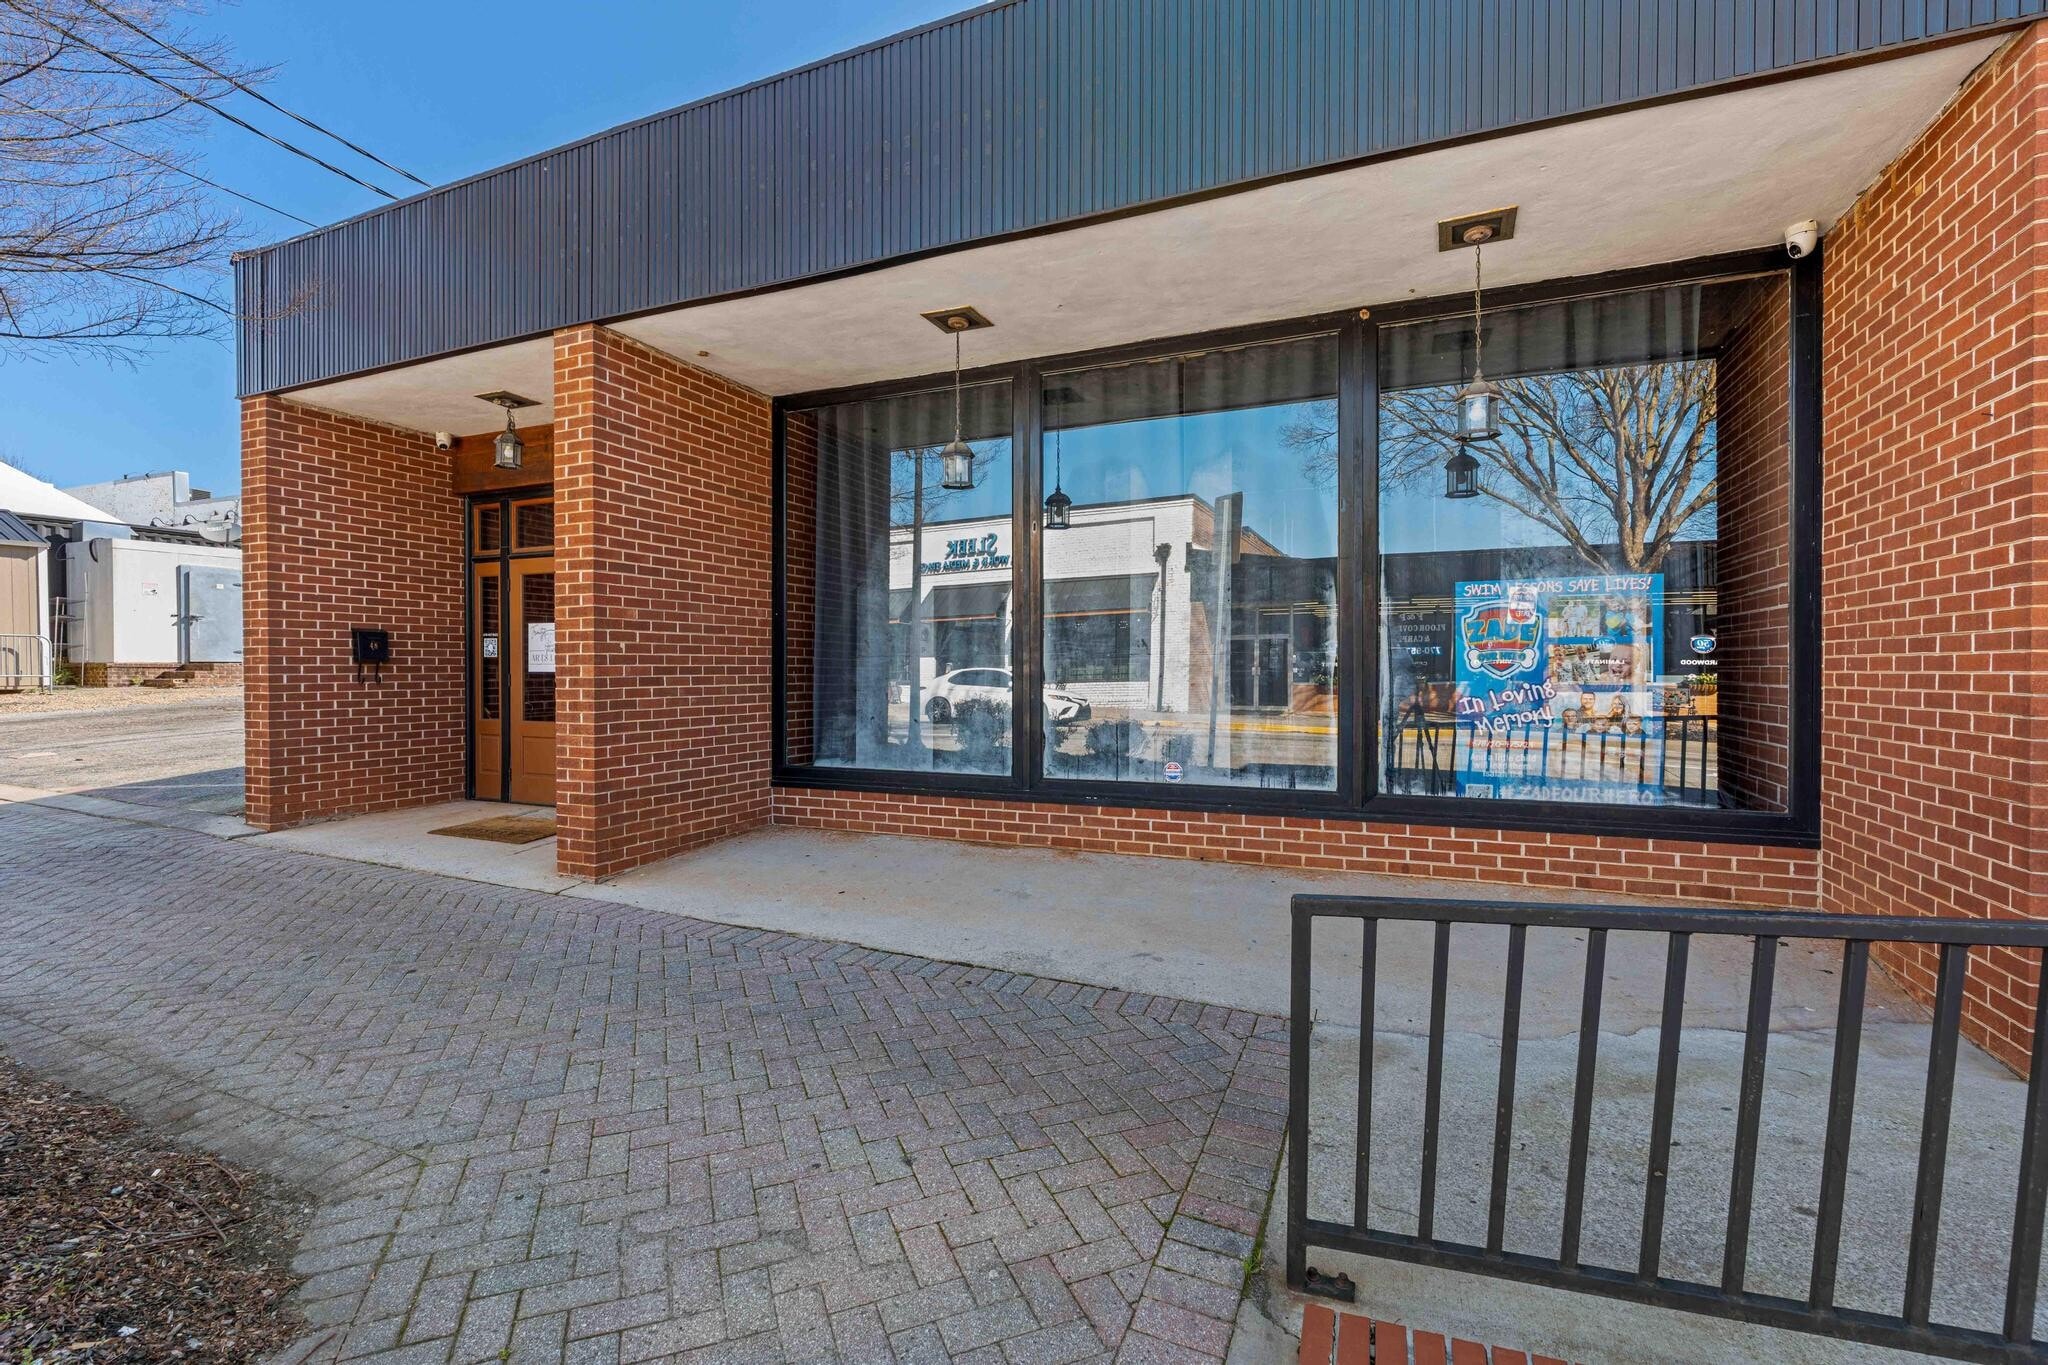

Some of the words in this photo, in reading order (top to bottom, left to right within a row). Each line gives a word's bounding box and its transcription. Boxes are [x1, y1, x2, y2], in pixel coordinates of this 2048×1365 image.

[1463, 582, 1501, 597] SWIM
[1567, 578, 1599, 593] SAVE
[1605, 576, 1652, 592] LIVES!
[1466, 618, 1539, 644] ZADE
[1459, 697, 1485, 715] In
[1489, 681, 1556, 712] Loving
[1474, 705, 1554, 735] Memory
